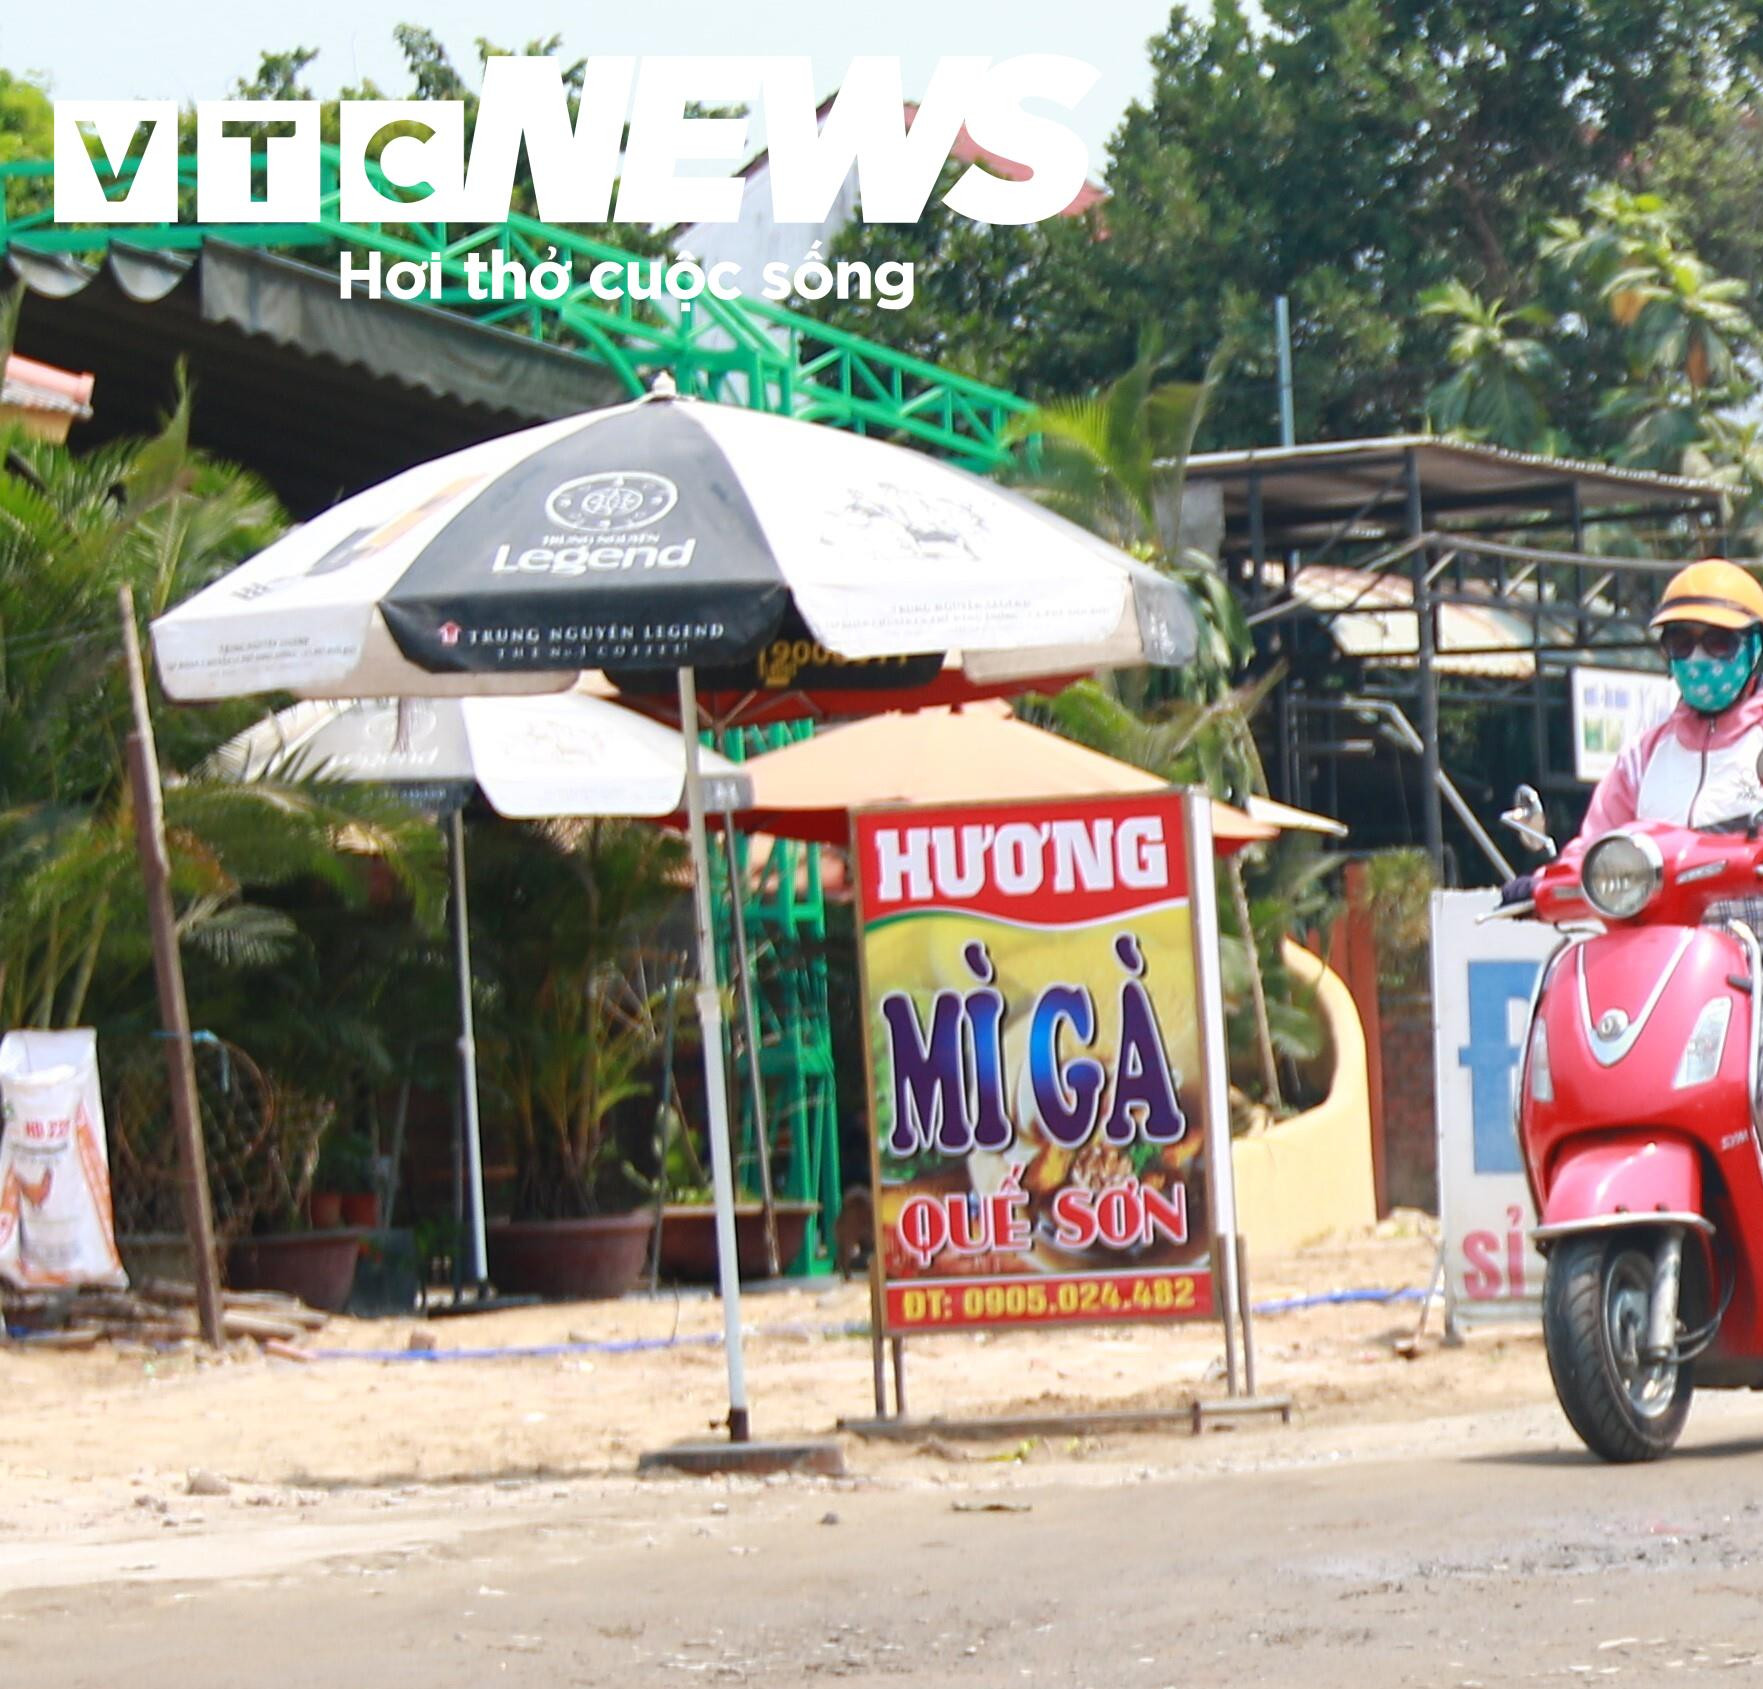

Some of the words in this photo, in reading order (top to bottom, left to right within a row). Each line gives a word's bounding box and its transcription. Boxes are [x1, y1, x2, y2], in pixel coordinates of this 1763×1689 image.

[492, 538, 697, 577] Legend
[468, 628, 540, 645] TRUNG
[643, 622, 725, 640] LEGEND
[876, 816, 1168, 902] HƯƠNG
[884, 940, 1014, 1156] MÌ
[1030, 933, 1186, 1150] GÀ
[898, 1166, 1032, 1267] QUẾ
[1054, 1178, 1190, 1248] SƠN
[1463, 1205, 1528, 1300] SỈ
[904, 1288, 952, 1321] ĐT:
[963, 1276, 1196, 1319] 0905.024.482
